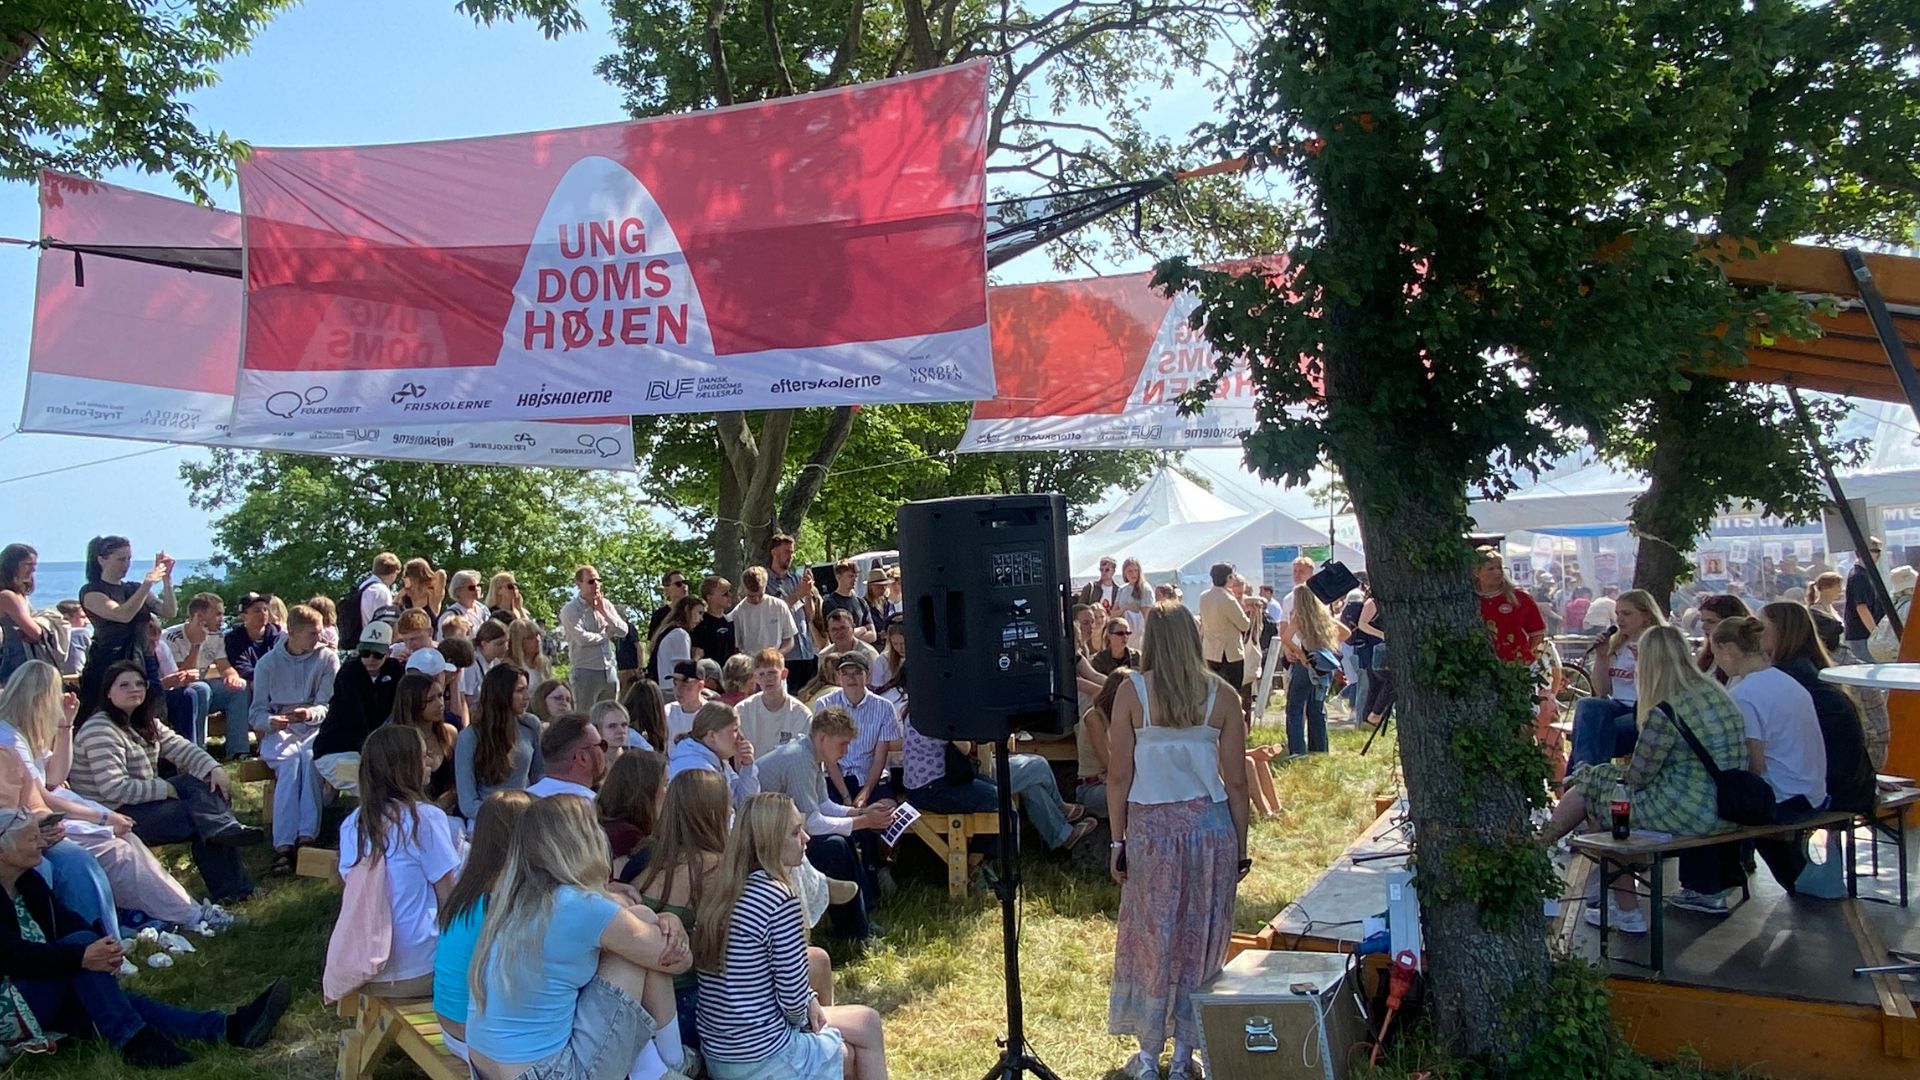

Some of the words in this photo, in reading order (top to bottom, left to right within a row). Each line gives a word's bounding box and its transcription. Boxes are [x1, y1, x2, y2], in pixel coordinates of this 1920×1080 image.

[558, 217, 647, 259] UNG
[536, 259, 672, 303] DOMS
[523, 304, 688, 351] HØJEN
[697, 383, 742, 391] UNGDOMS
[698, 376, 728, 384] DANSK
[770, 375, 881, 393] efterskolerne
[645, 378, 695, 401] DUF
[300, 406, 361, 415] FOLKEMØDET
[403, 400, 493, 411] FRISKOLERNE
